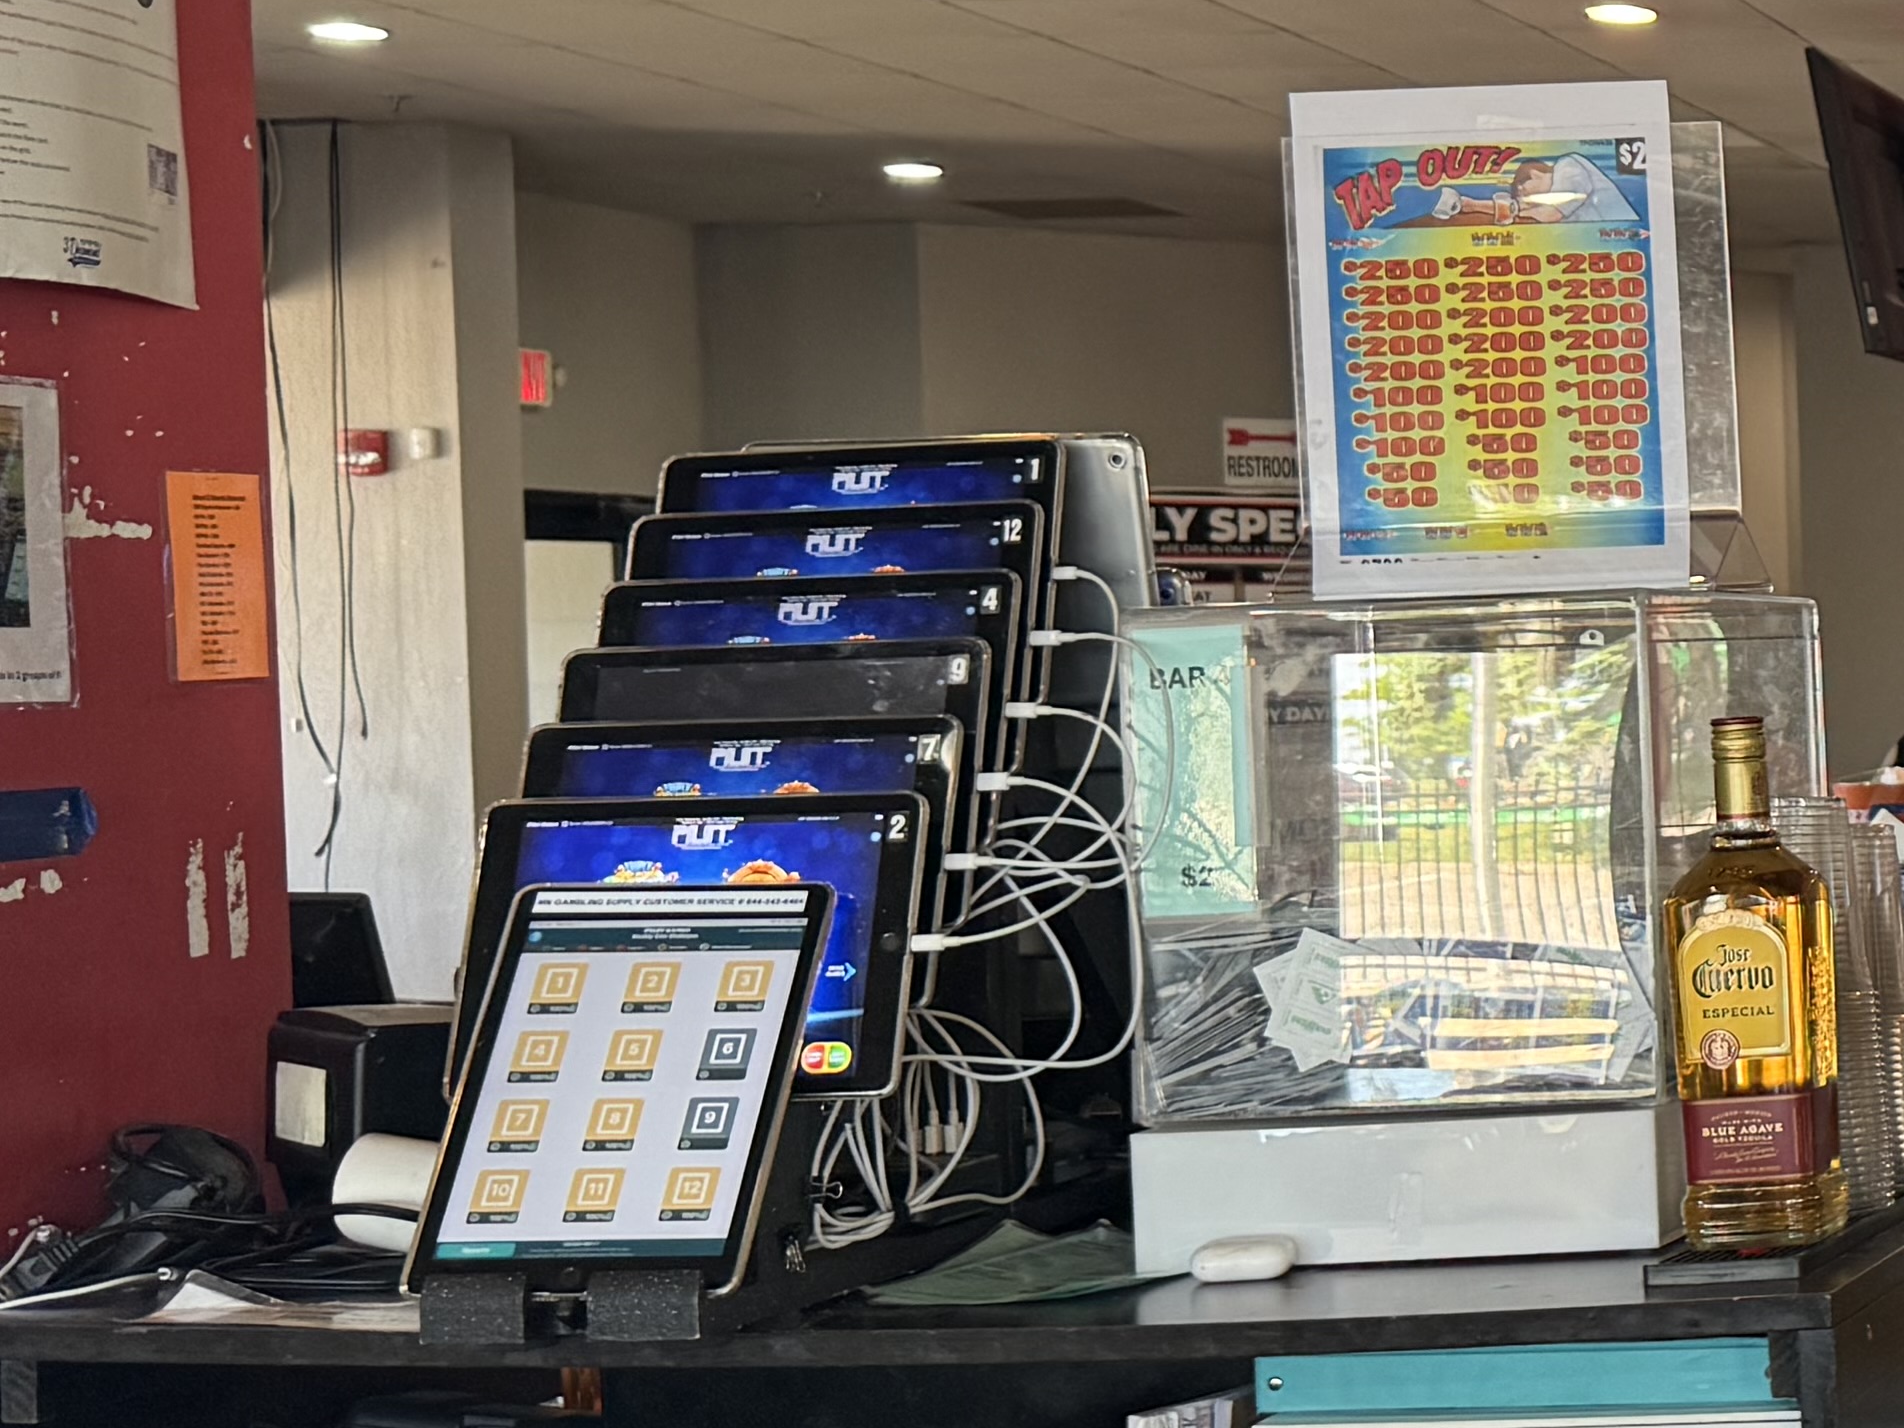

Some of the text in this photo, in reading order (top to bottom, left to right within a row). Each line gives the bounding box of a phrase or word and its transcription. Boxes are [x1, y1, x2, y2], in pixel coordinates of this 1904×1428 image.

[1619, 141, 1647, 170] $2
[1335, 160, 1402, 230] TAP
[1030, 458, 1040, 480] 1
[1003, 519, 1022, 542] 12
[982, 588, 998, 611] 4
[952, 657, 967, 683] 9
[921, 737, 939, 762] 7
[890, 815, 906, 839] 2
[1717, 944, 1751, 966] Jose
[1692, 958, 1774, 998] Cuervo
[1703, 1005, 1775, 1019] ESPECIAL
[1702, 1123, 1783, 1137] BLUE AGAVE
